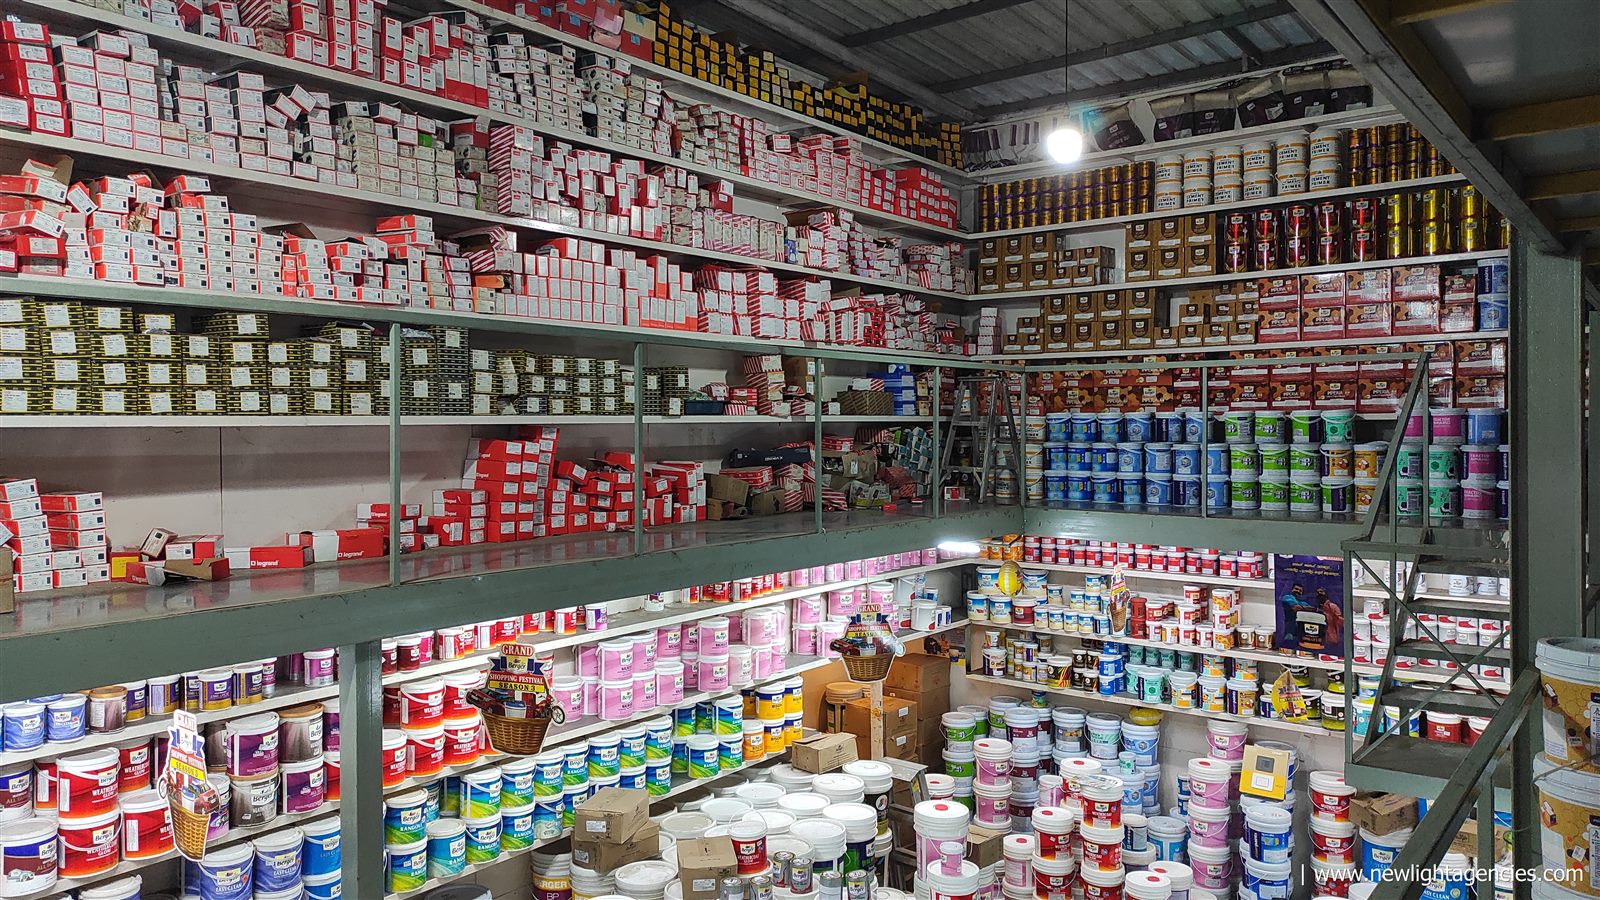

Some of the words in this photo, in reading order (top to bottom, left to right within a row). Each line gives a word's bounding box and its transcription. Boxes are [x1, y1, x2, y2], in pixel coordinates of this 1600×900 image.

[344, 550, 364, 558] legrand
[502, 645, 532, 656] GRAND
[490, 674, 518, 682] SHOPPING
[518, 676, 544, 684] FESTIVAL
[498, 682, 528, 691] SEASON
